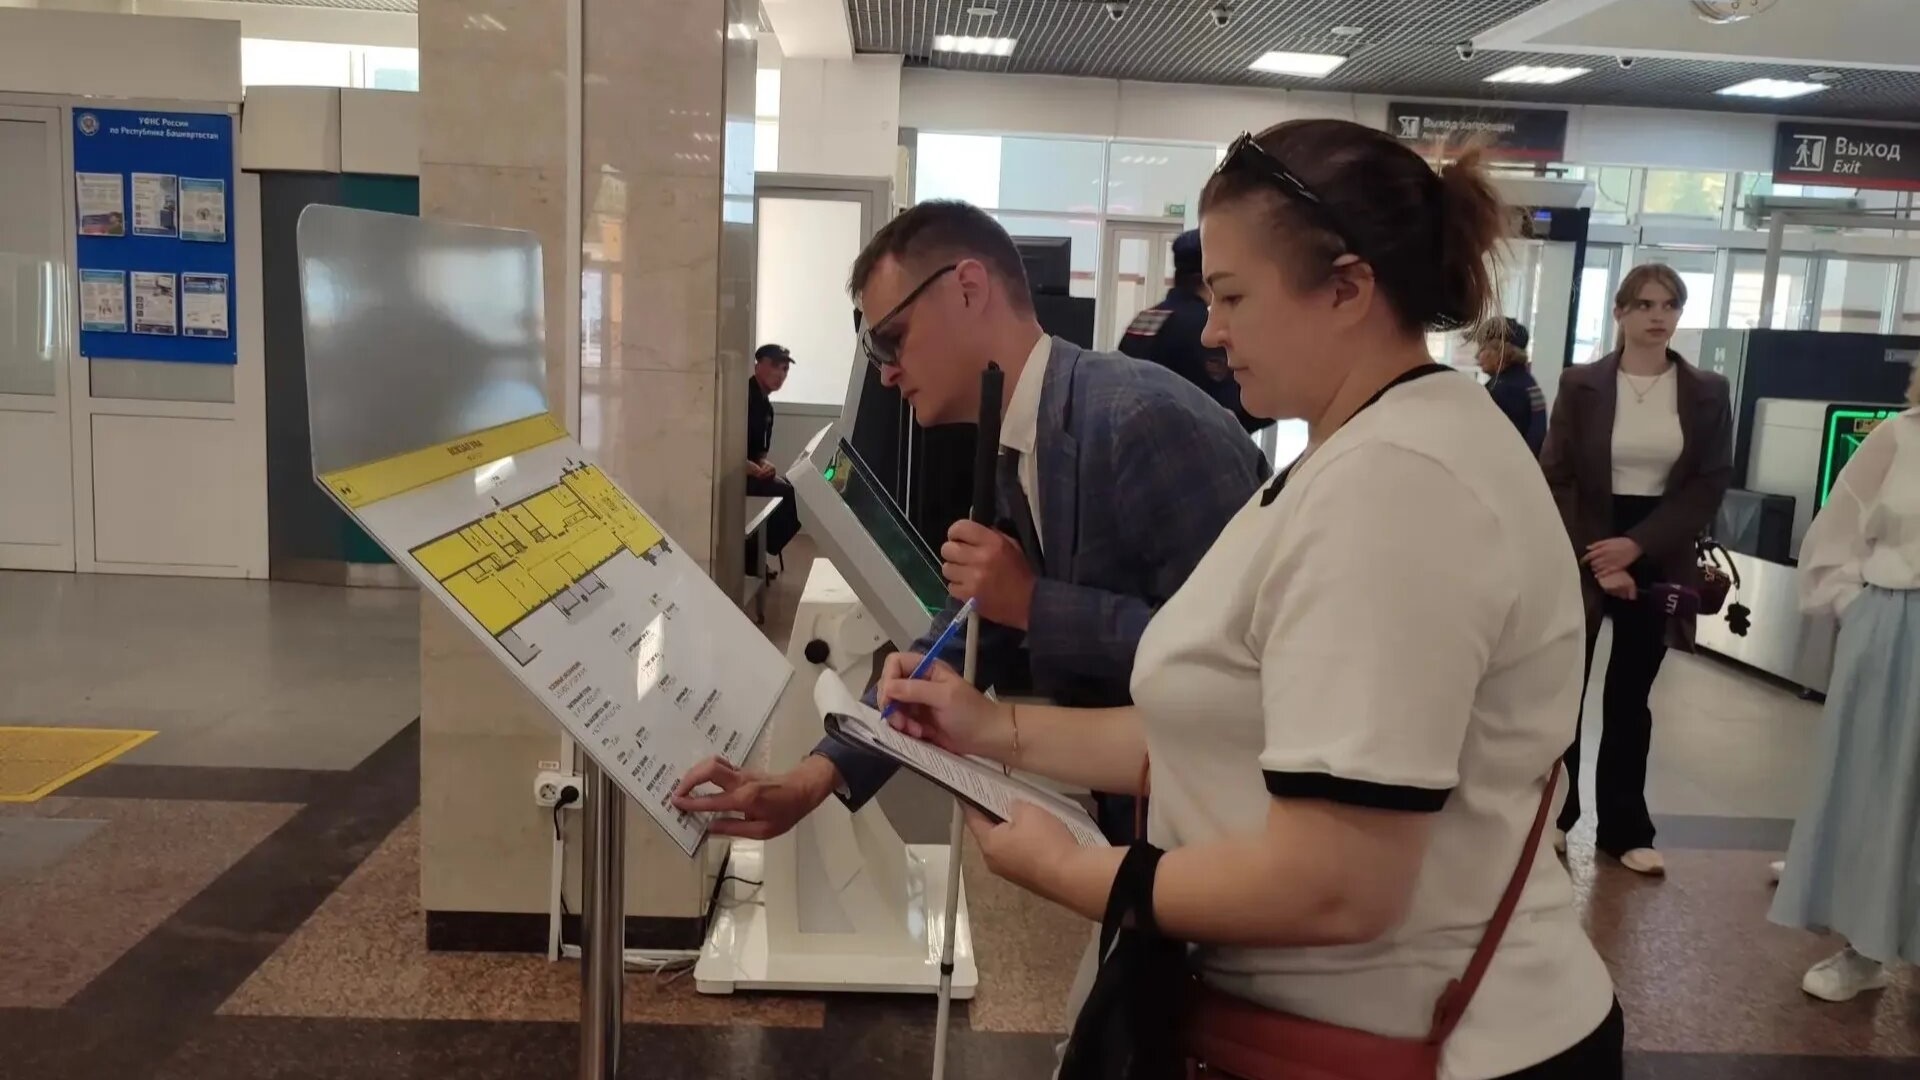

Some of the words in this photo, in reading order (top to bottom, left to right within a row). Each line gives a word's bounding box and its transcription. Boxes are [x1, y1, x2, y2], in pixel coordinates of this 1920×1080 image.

[138, 116, 161, 126] УФНС
[162, 118, 189, 128] России
[1423, 117, 1458, 130] Выход
[109, 127, 119, 135] по
[1835, 136, 1901, 161] Выход
[1832, 159, 1862, 174] Exit
